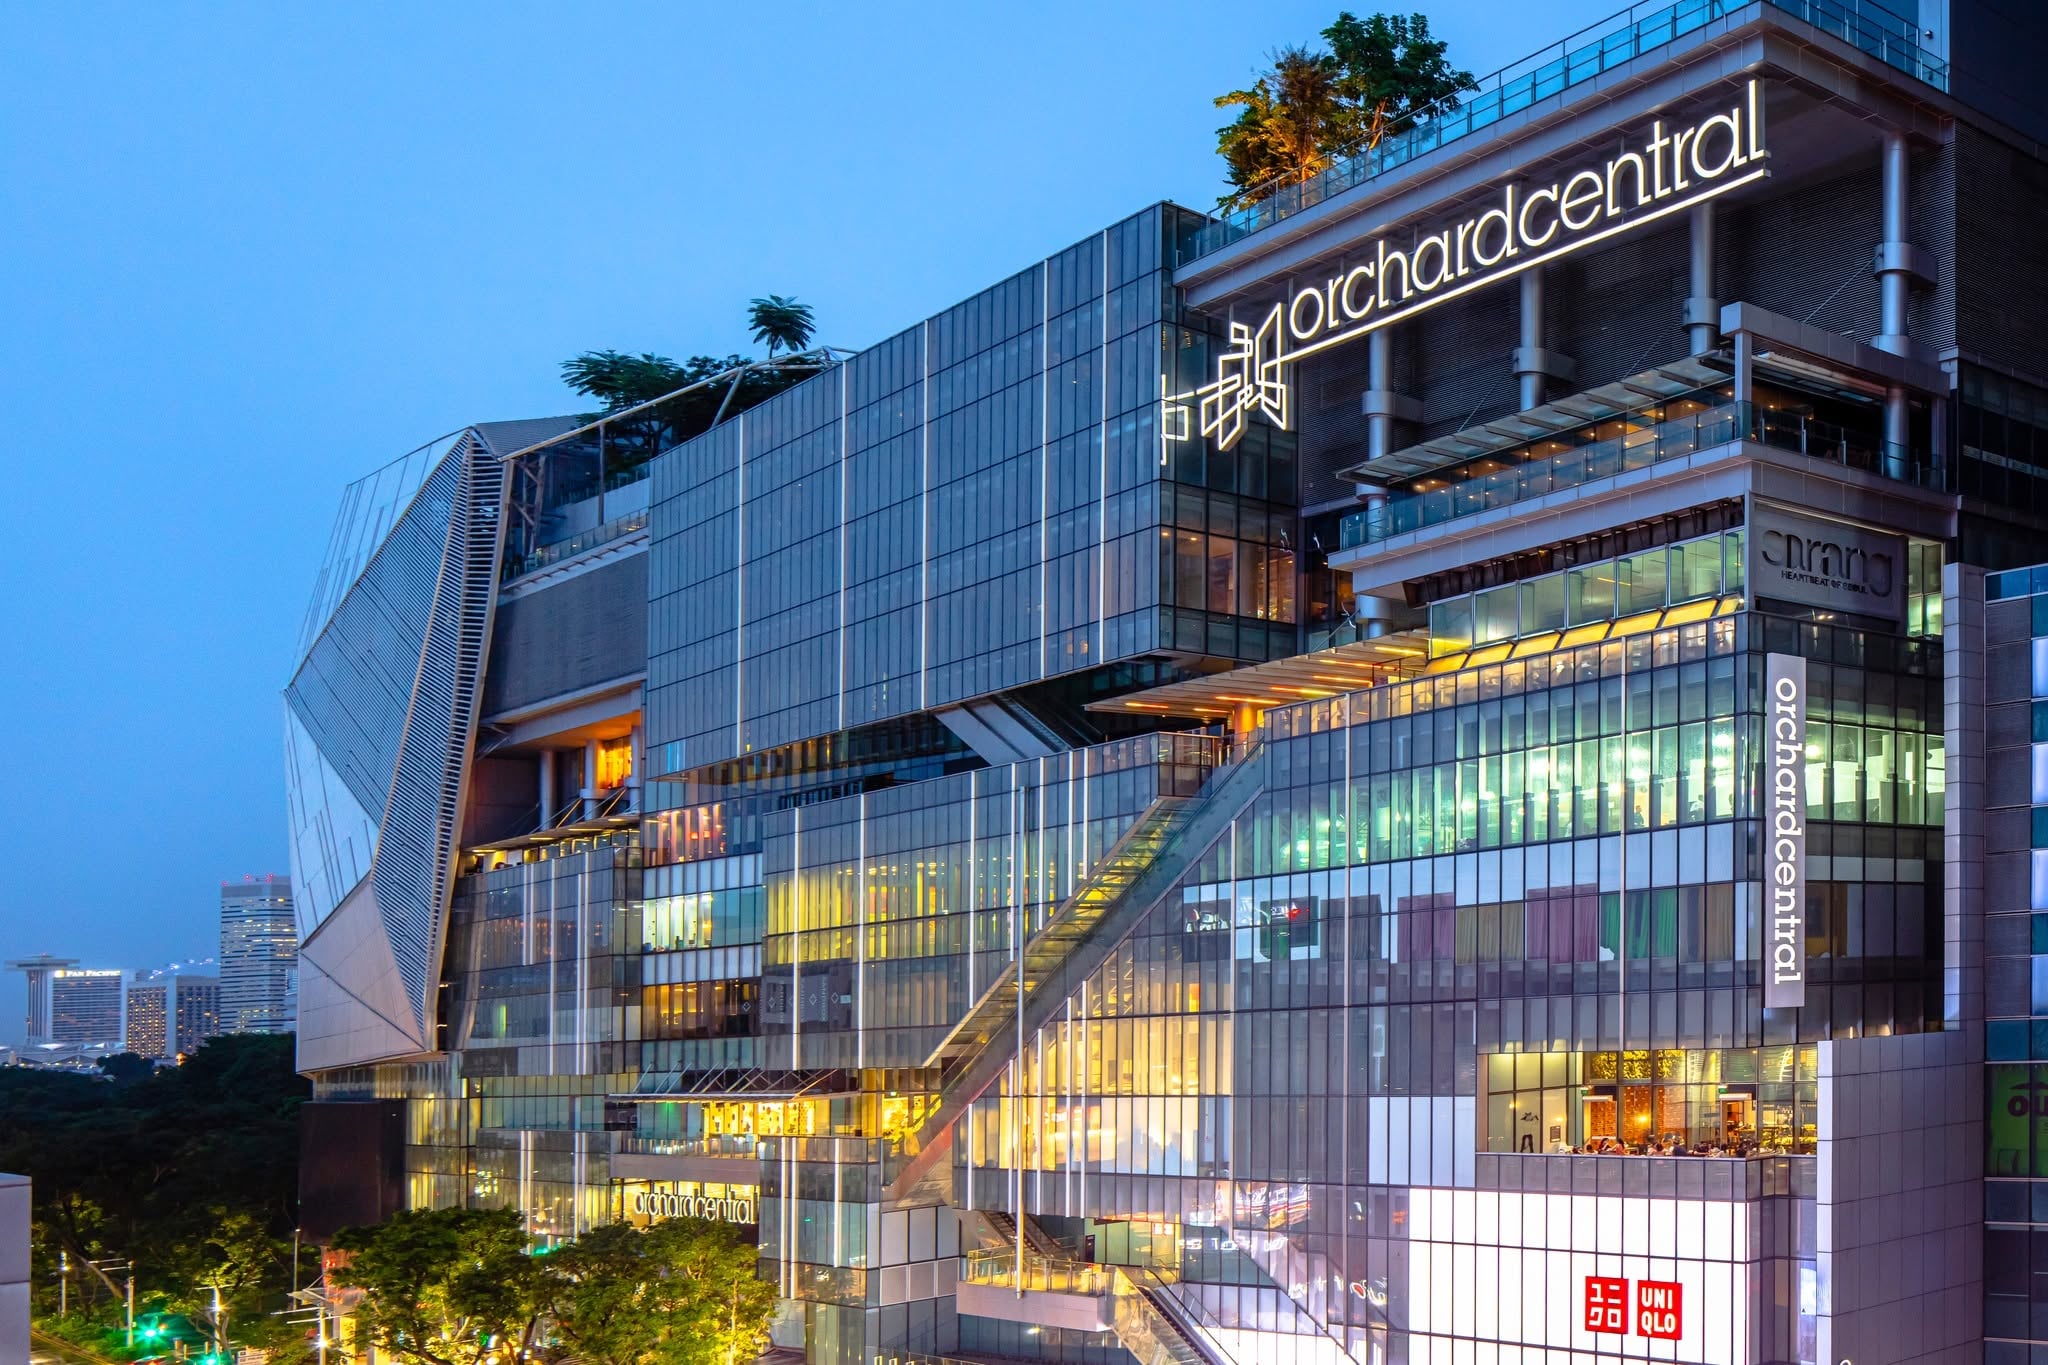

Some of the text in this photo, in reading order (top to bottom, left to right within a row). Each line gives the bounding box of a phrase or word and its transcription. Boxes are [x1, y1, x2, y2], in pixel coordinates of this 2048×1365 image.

[1289, 80, 1766, 340] orchardcentral
[1781, 569, 1868, 594] HEARTBEAT OF SEOUL
[1774, 677, 1803, 985] orchardcentral
[634, 1186, 756, 1225] orchardcentral
